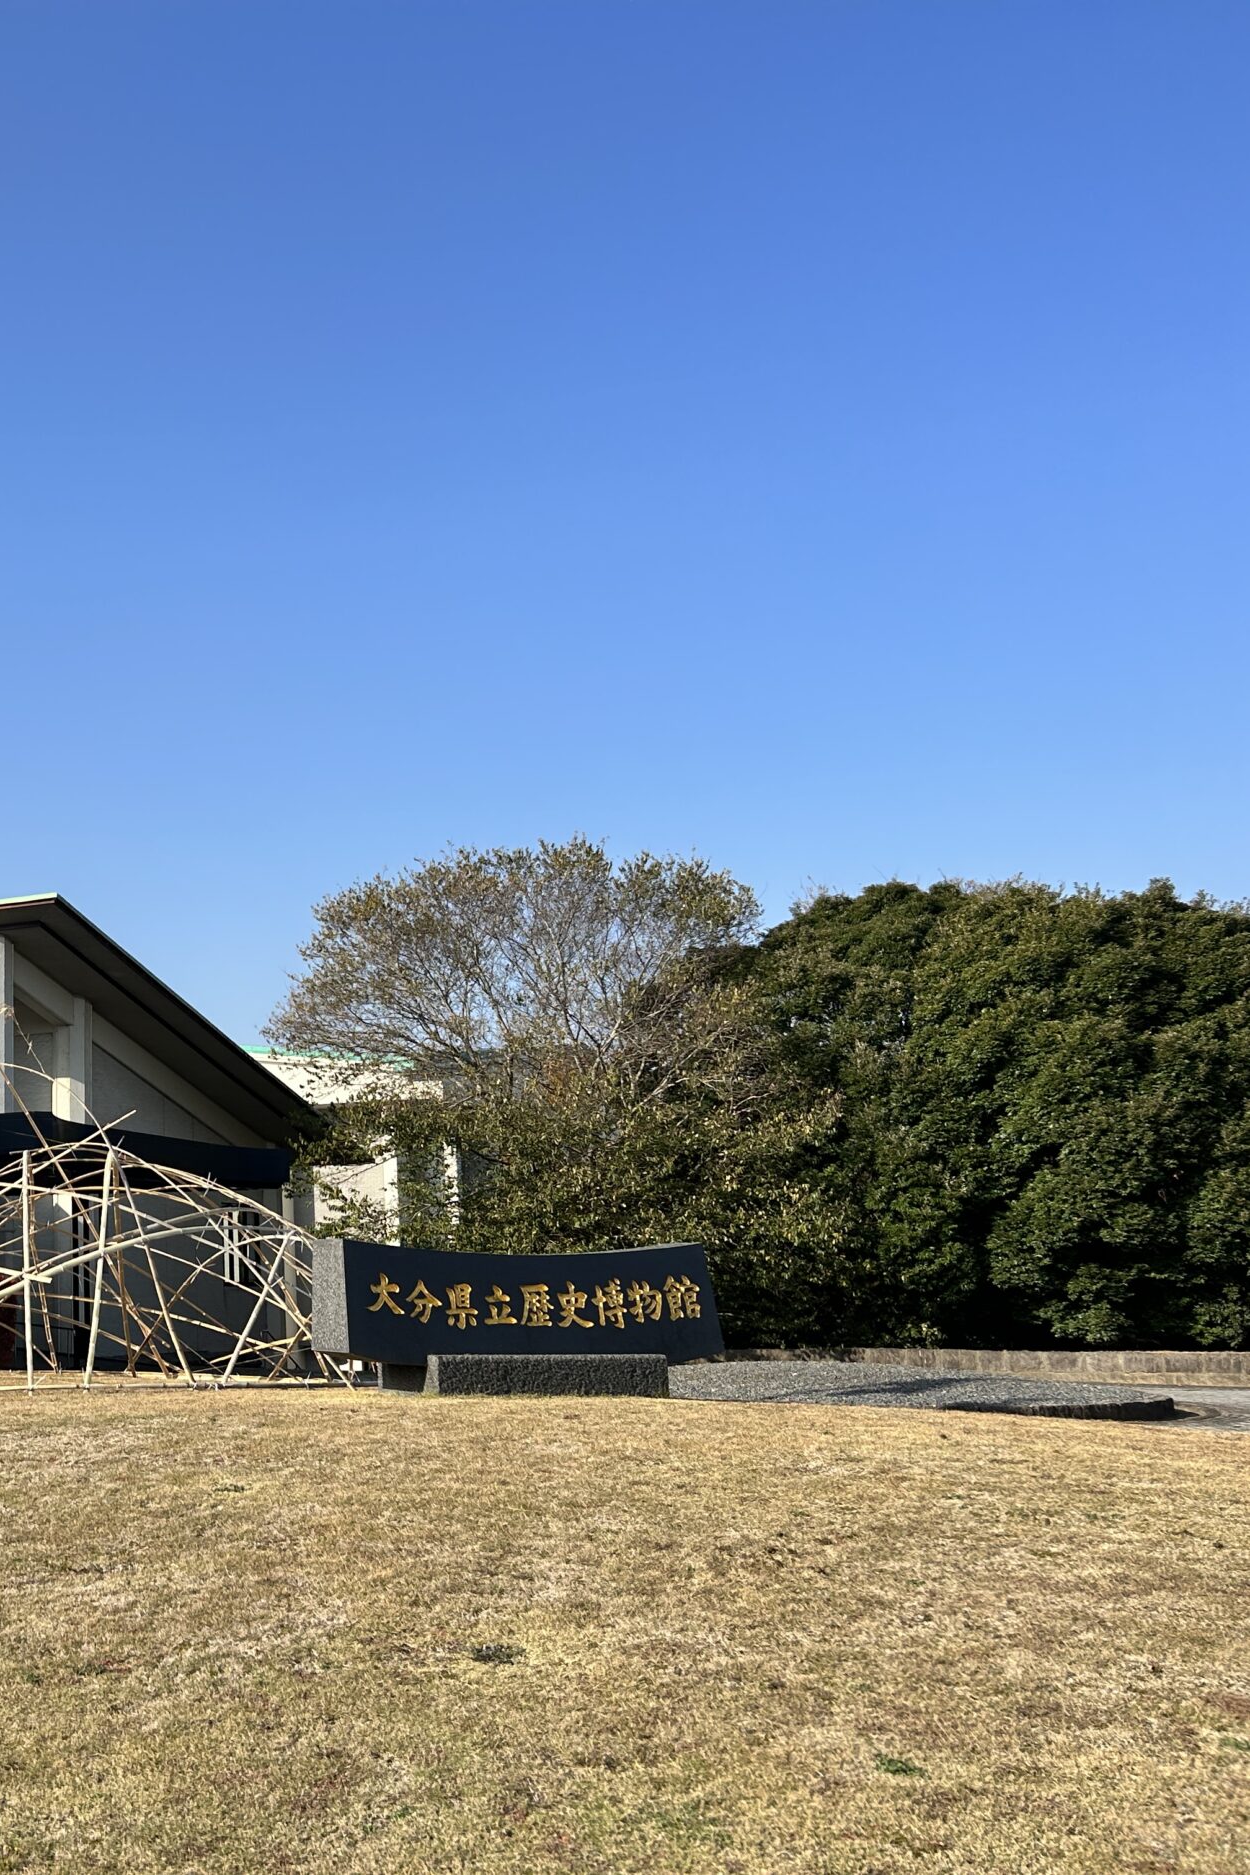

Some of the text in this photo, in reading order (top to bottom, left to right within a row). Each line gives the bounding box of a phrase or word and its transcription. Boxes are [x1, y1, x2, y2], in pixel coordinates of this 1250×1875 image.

[367, 1272, 701, 1330] 大分県立歴史博物館
